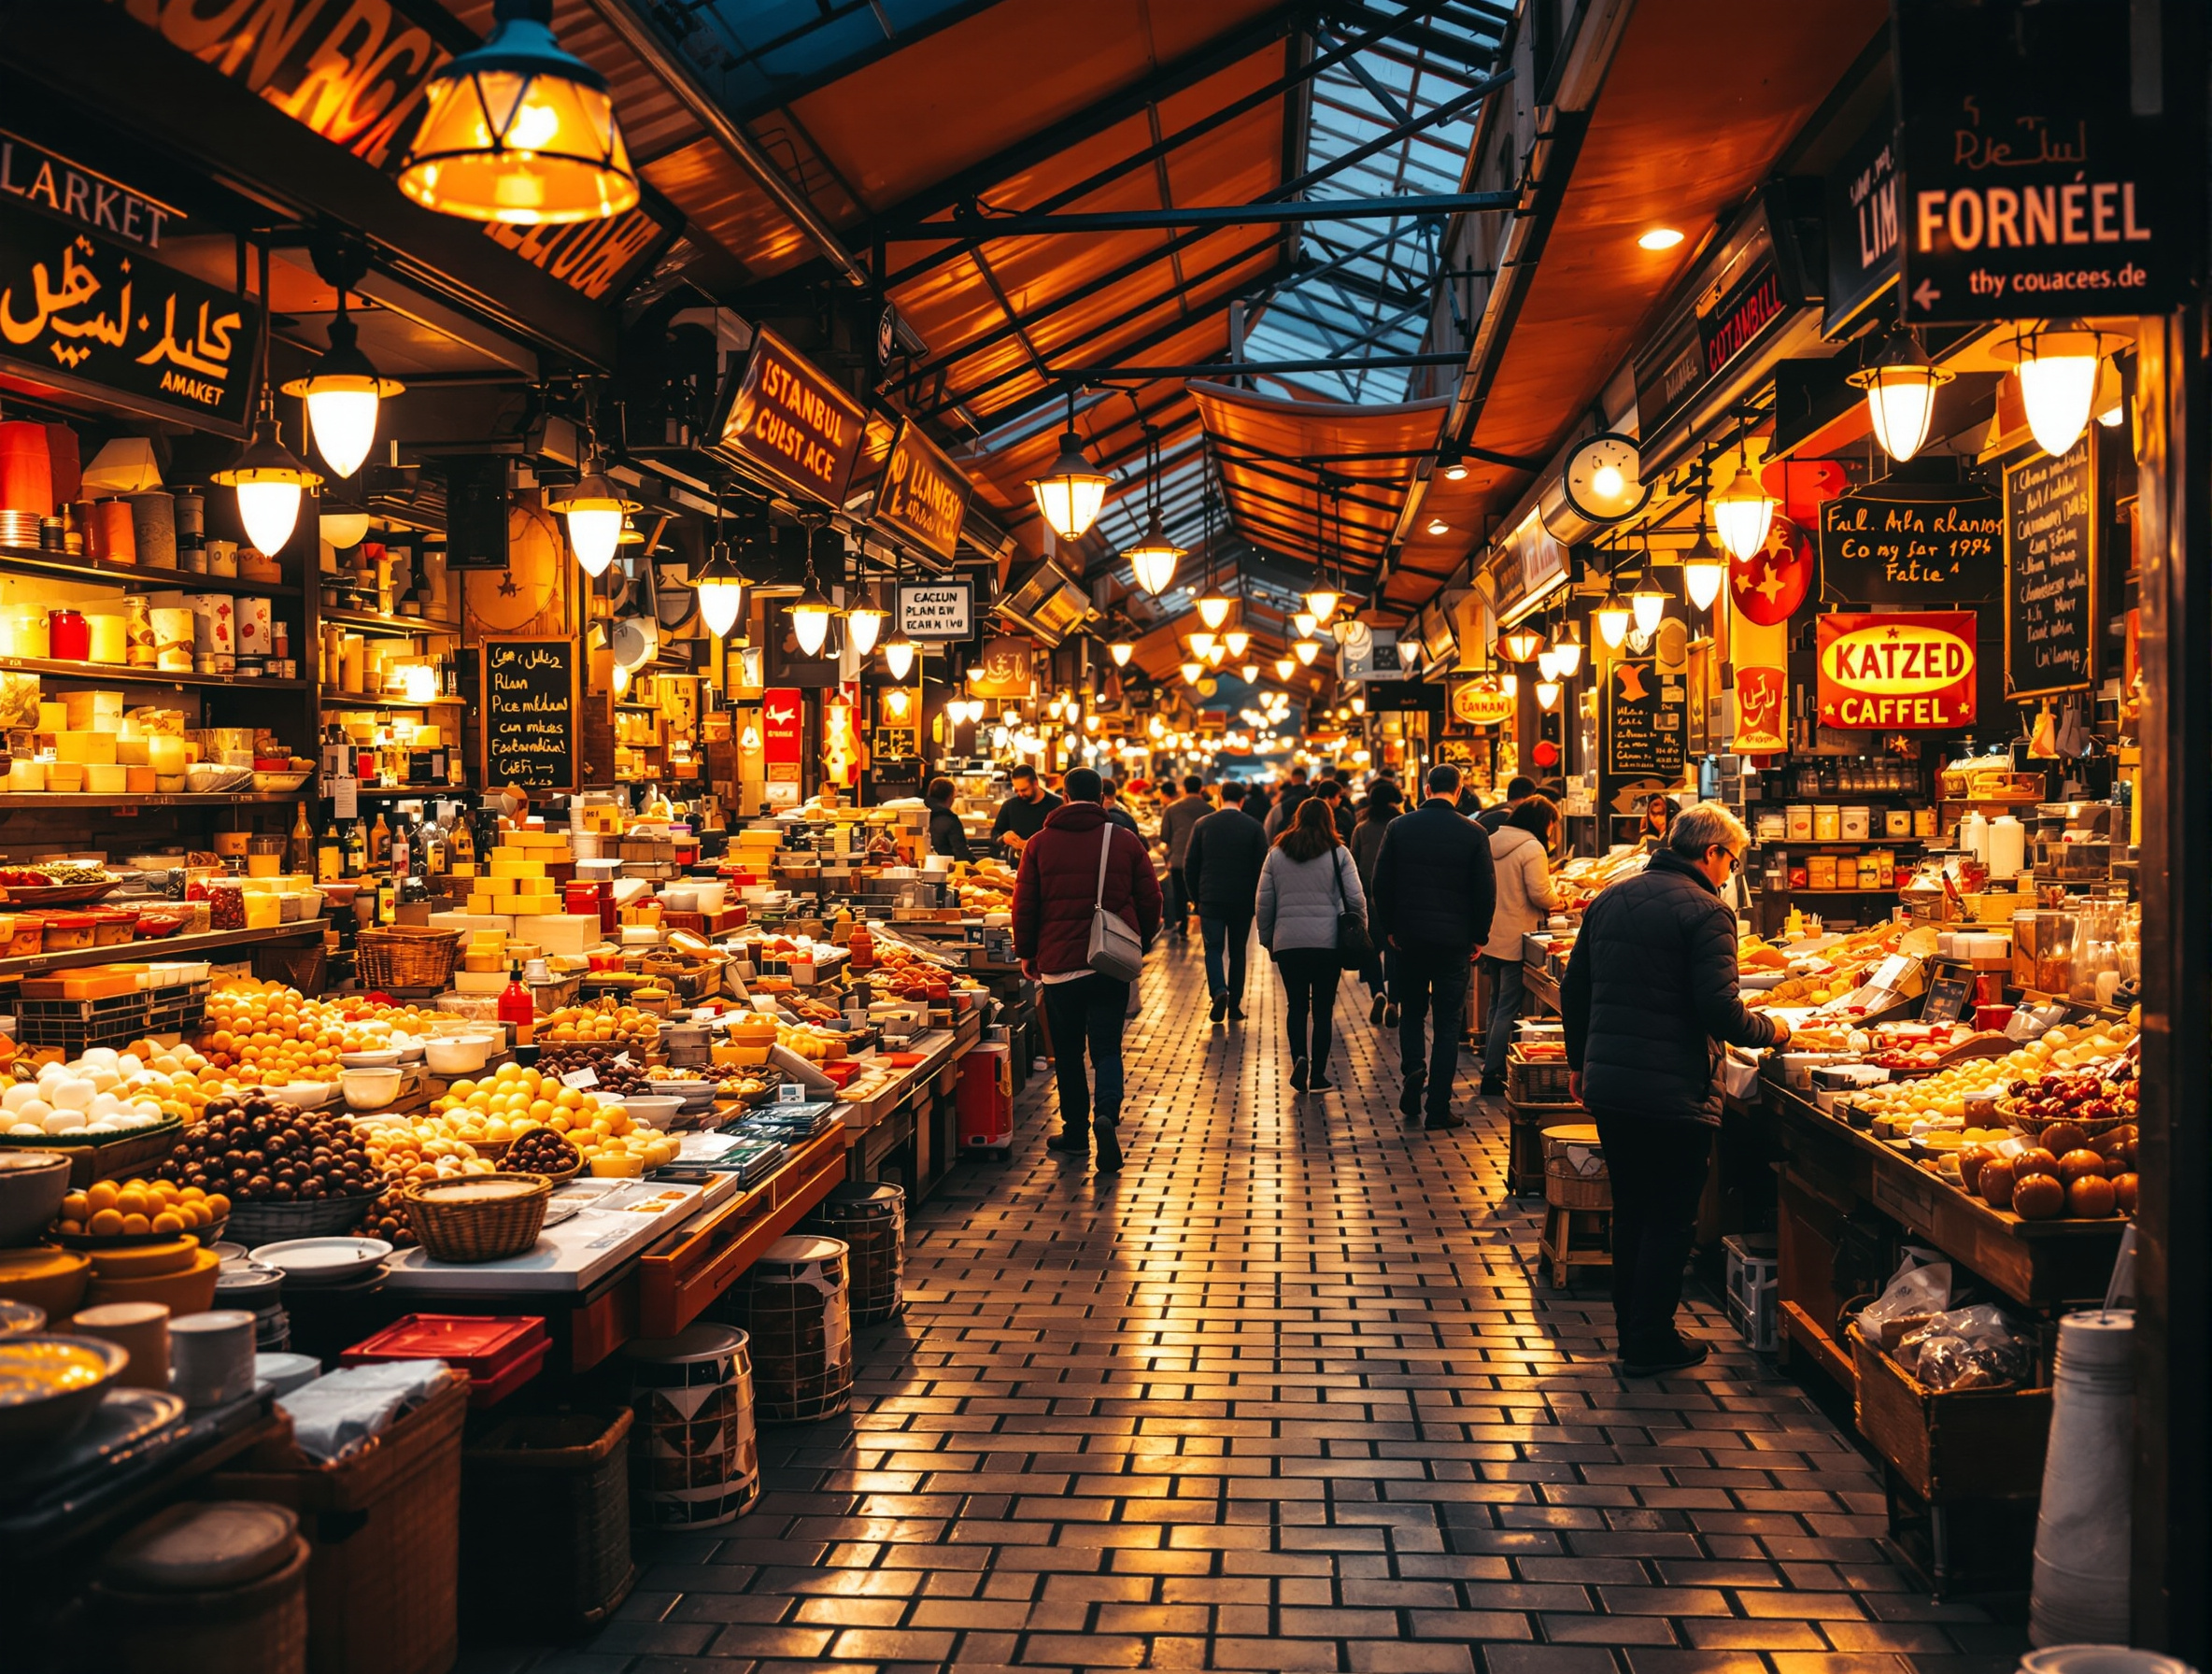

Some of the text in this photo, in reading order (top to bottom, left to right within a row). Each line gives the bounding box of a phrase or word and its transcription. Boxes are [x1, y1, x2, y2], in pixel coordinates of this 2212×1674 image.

[0, 143, 168, 249] LARKET
[1918, 170, 2151, 253] FORNÉEL
[1968, 267, 2006, 298] thy
[160, 370, 225, 406] AMAKET
[761, 358, 843, 448] ISTANBUL
[1836, 642, 1965, 680] KATZED
[1840, 697, 1950, 725] CAFFEL
